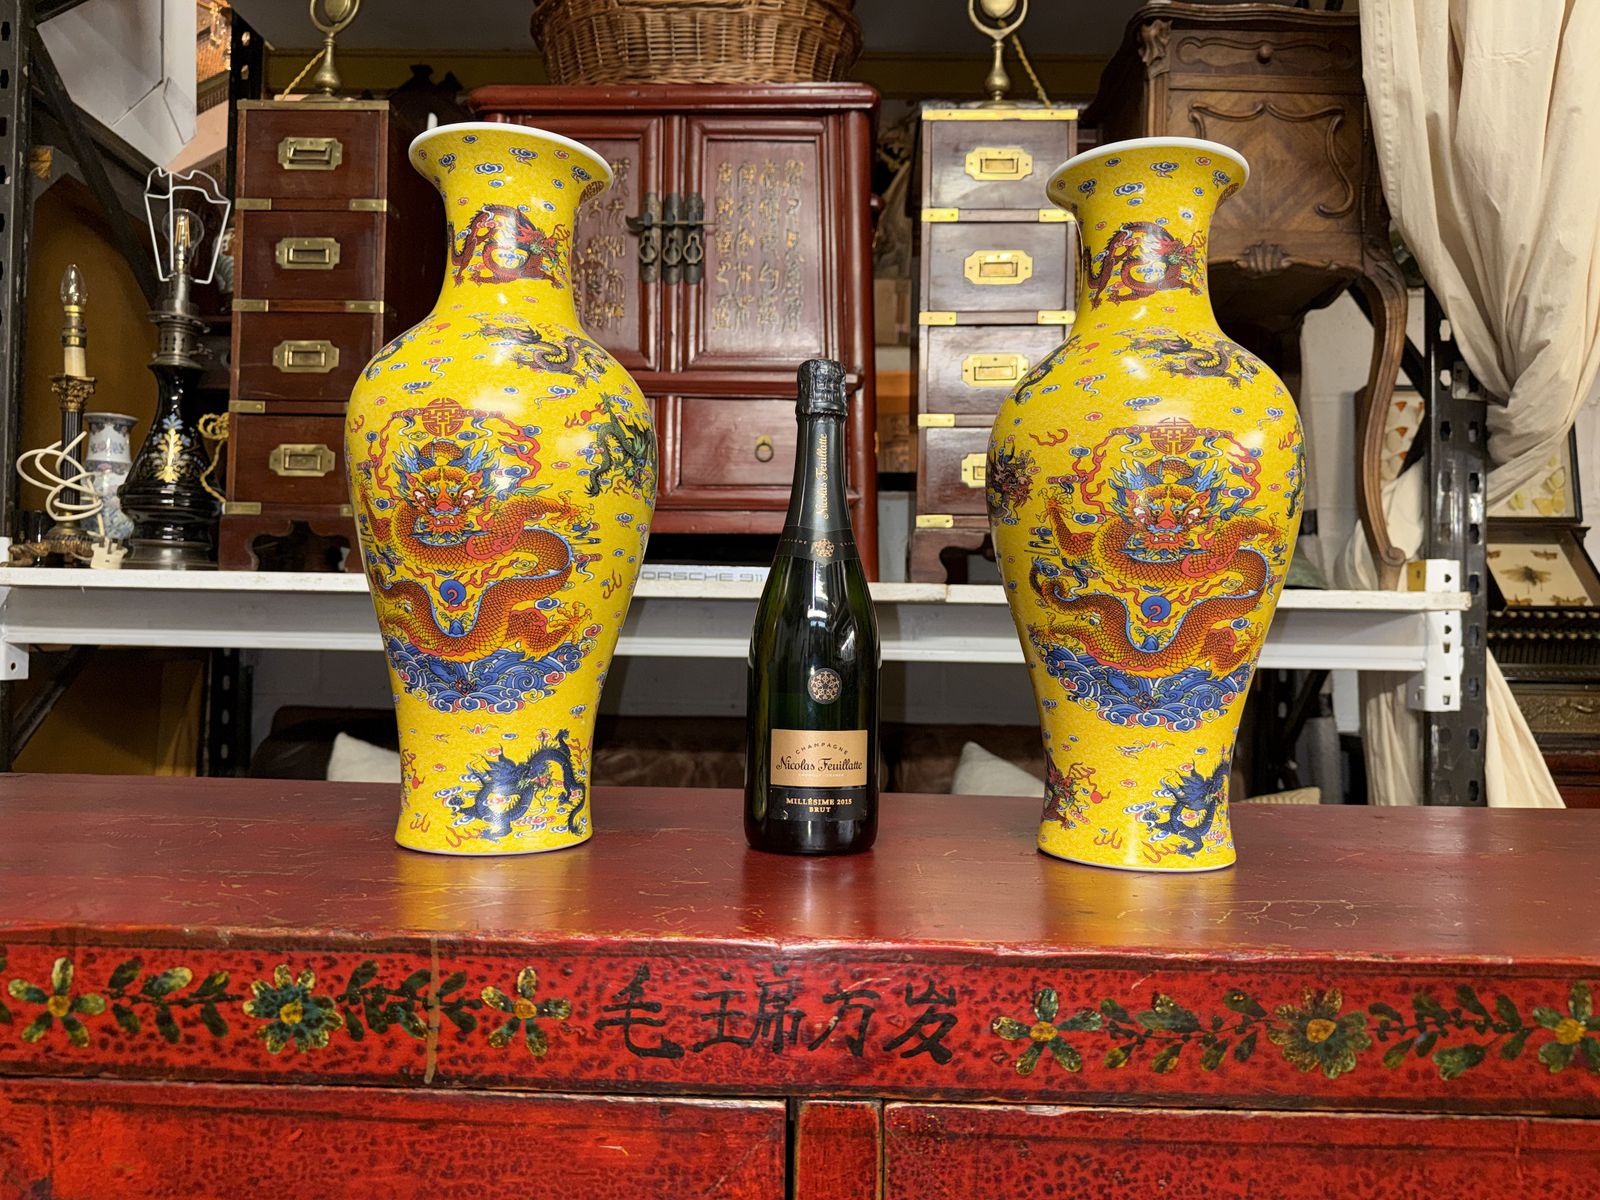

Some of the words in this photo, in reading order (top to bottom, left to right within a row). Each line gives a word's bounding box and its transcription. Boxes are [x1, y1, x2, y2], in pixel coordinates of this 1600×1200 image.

[816, 433, 828, 480] Feuillatte
[815, 482, 829, 519] Nicolas
[641, 571, 733, 582] ORSCHE
[739, 573, 763, 583] 911
[795, 742, 848, 754] CHAMPAGNE
[776, 756, 815, 770] Nicolas
[818, 758, 863, 771] Feuillatte
[593, 961, 957, 1065] 毛主席万岁
